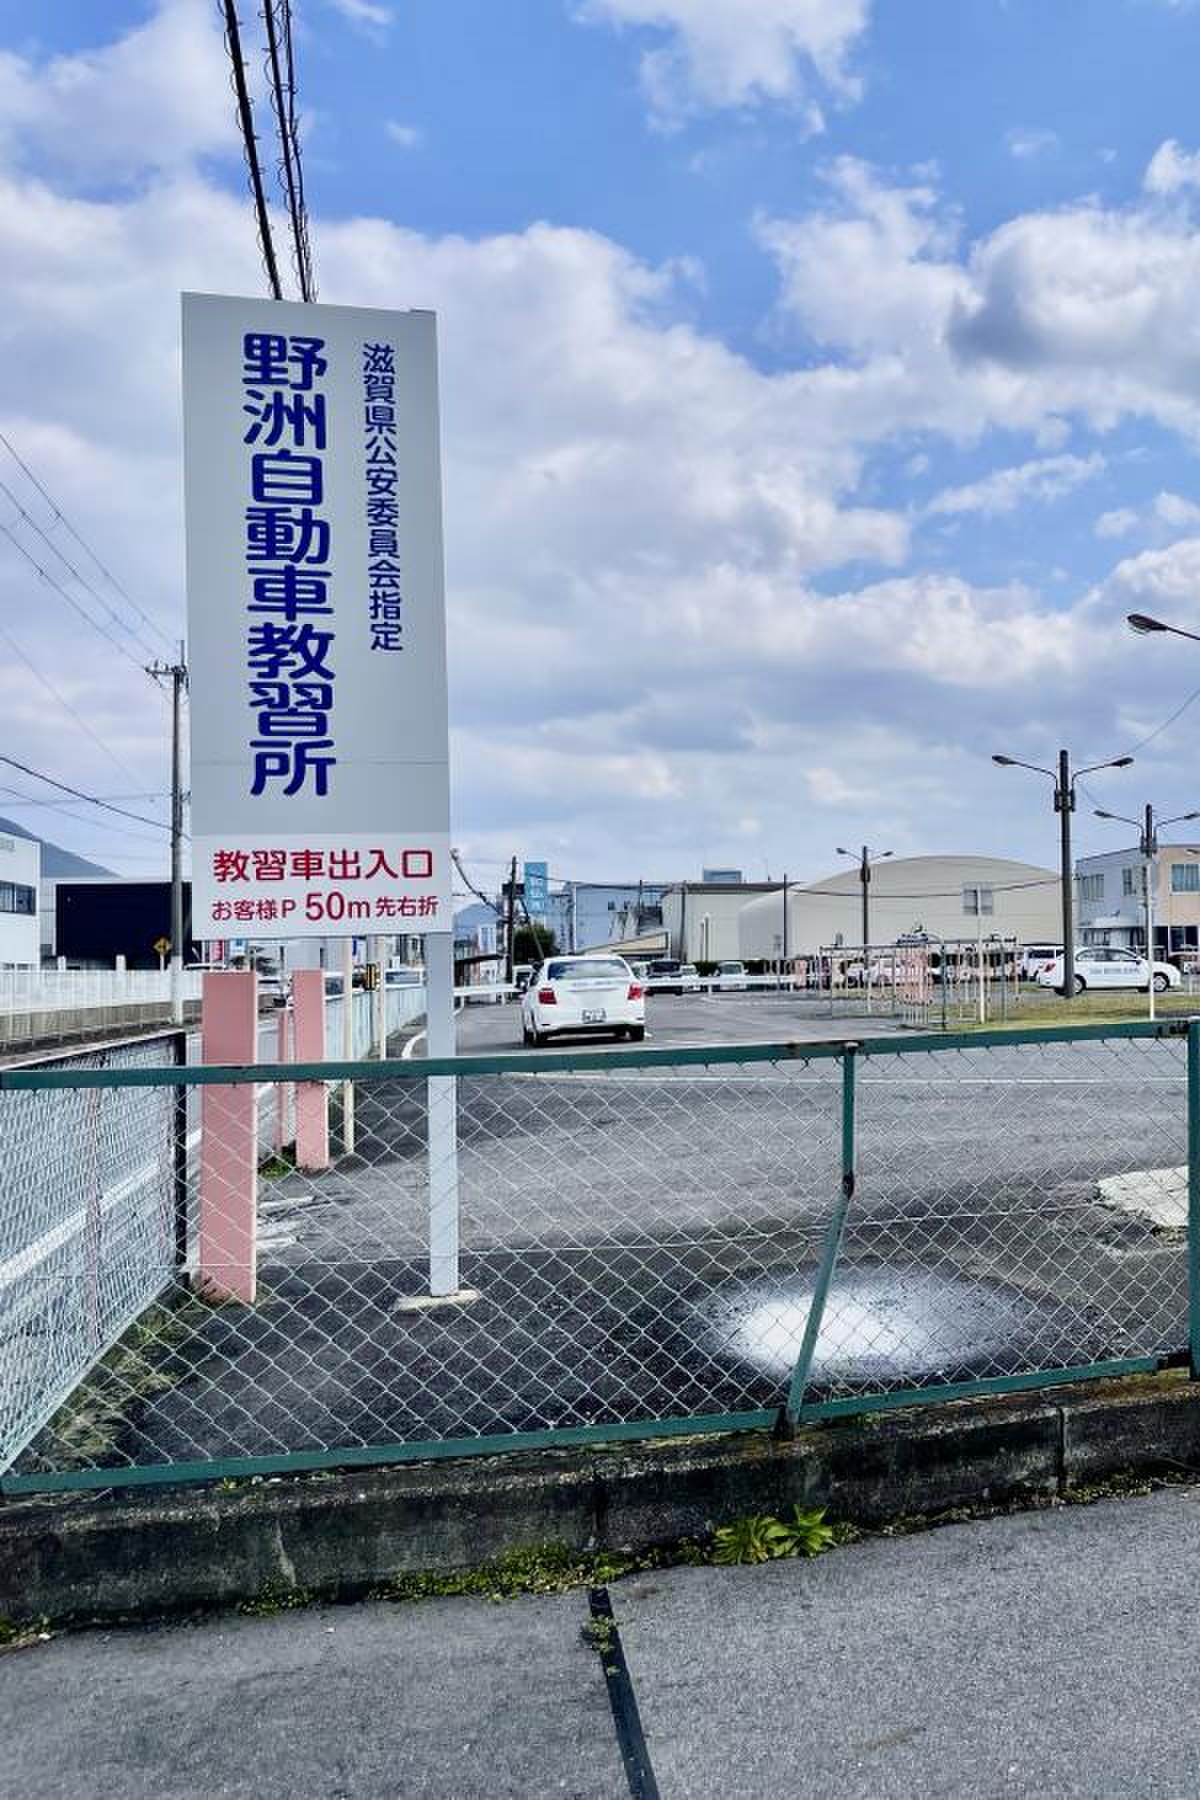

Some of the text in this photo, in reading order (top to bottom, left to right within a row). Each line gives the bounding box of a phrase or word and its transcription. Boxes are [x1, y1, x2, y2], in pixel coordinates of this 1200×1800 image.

[242, 332, 338, 797] 野洲自動車教習所
[362, 342, 405, 652] 滋賀県公安委員会指定
[213, 849, 434, 882] 教習車出入口
